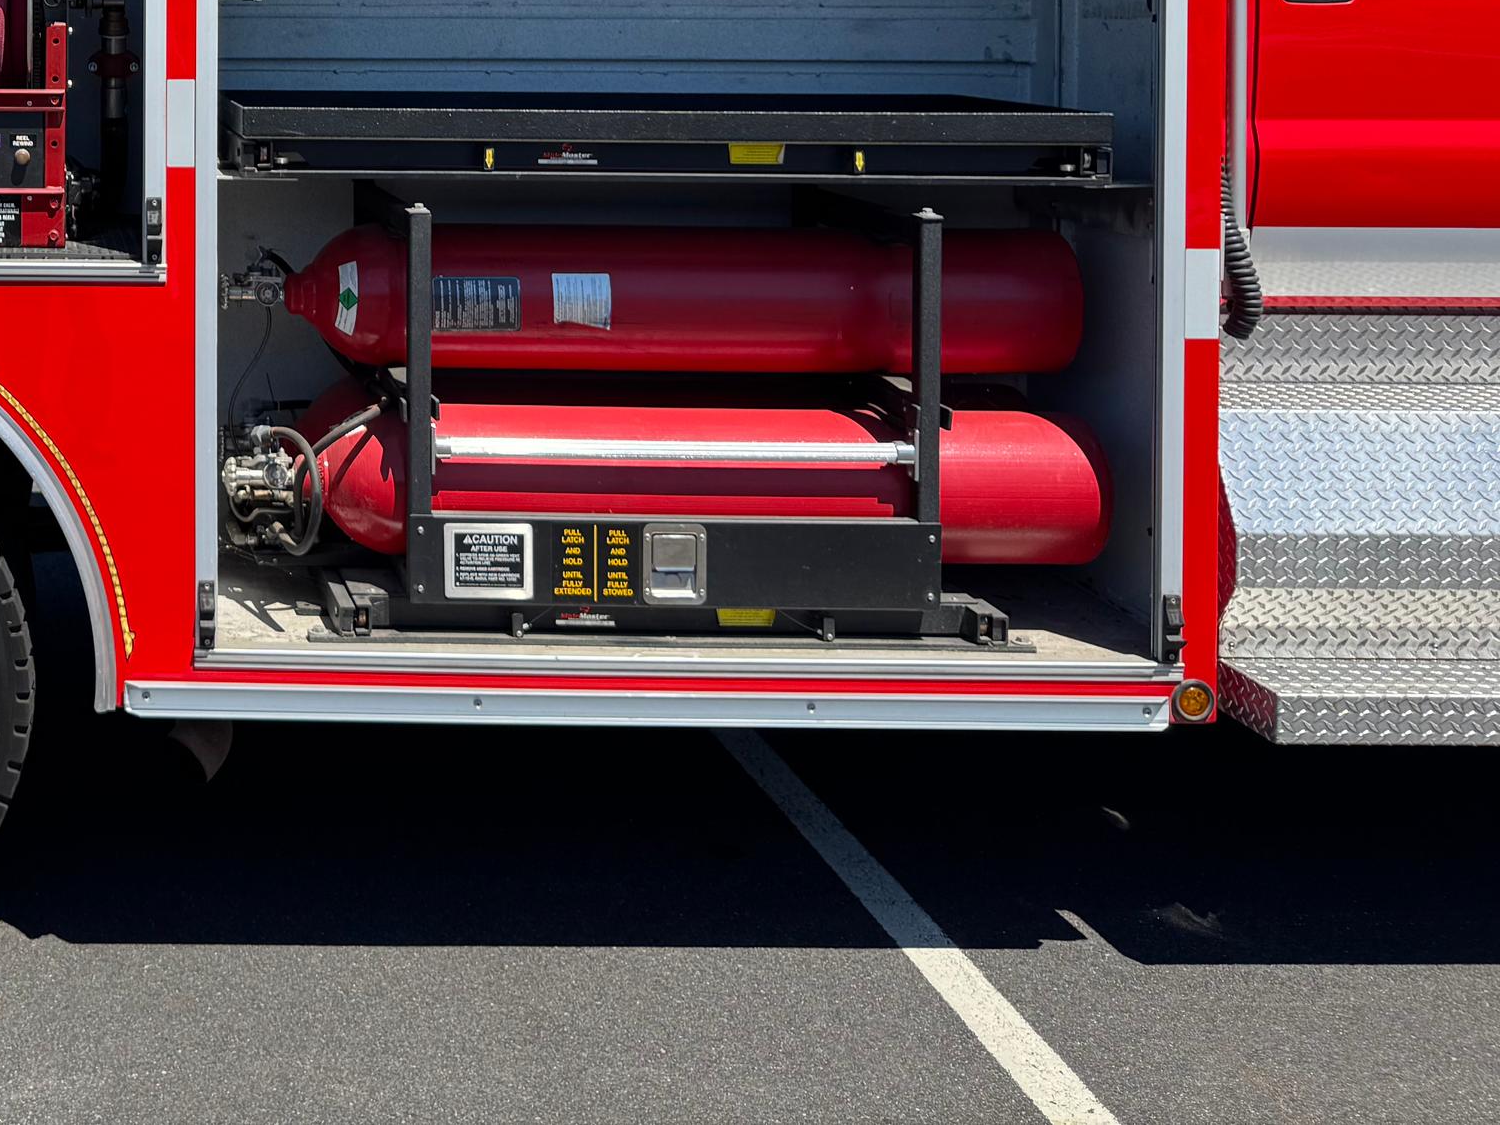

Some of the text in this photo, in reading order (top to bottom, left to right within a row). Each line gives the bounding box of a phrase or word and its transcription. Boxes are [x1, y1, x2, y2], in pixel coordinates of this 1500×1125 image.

[608, 529, 627, 537] PULL
[471, 534, 518, 545] CAUTION
[561, 536, 585, 544] LATCH
[606, 537, 630, 545] LATCH
[494, 545, 508, 553] USE
[565, 547, 581, 555] AND
[610, 548, 626, 556] AND
[563, 557, 583, 566] HOLD
[608, 558, 628, 566] HOLD
[563, 571, 583, 579] UNTIL
[607, 571, 628, 580] UNTIL
[563, 580, 583, 588] FULLY
[554, 587, 592, 595] EXTENDED
[603, 588, 634, 596] STOWED
